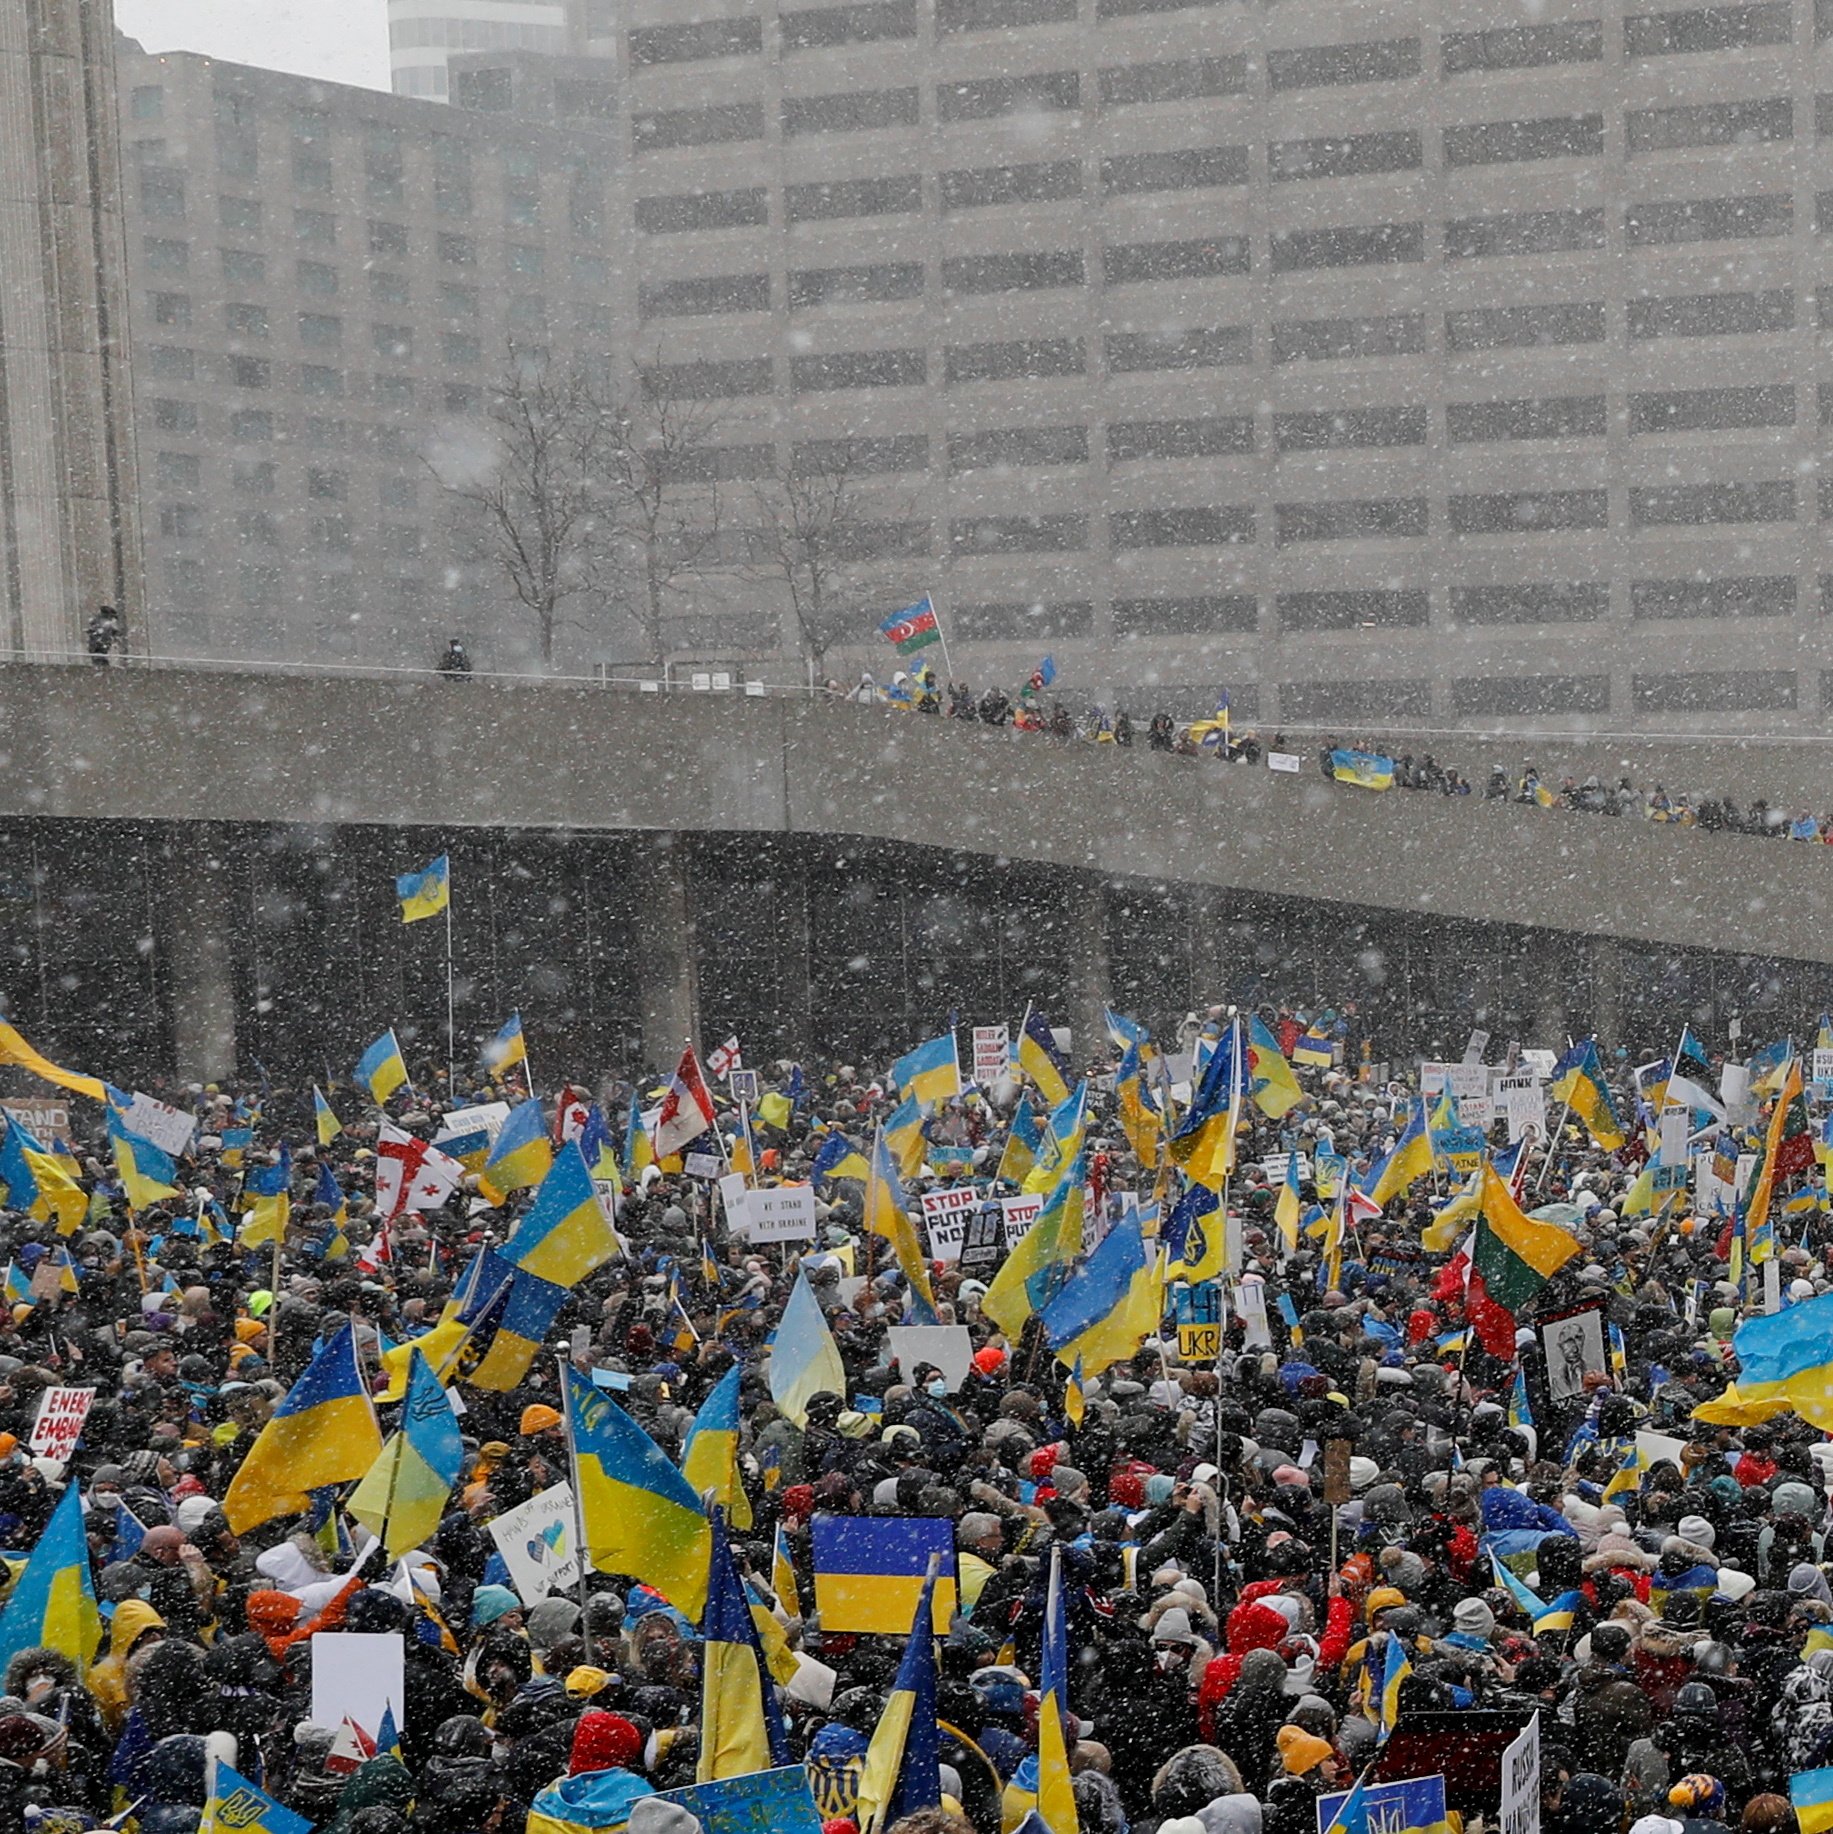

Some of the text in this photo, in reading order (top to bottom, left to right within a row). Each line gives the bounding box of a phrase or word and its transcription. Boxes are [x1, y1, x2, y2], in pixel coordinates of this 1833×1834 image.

[9, 1109, 67, 1126] TAND
[764, 1200, 802, 1211] WE STAND
[924, 1195, 973, 1211] STOP
[759, 1218, 807, 1230] WITH UKRAINE
[1007, 1225, 1030, 1239] PUT
[938, 1226, 965, 1244] NO
[1178, 1330, 1220, 1356] UKR
[1512, 1737, 1534, 1796] RUSSIA
